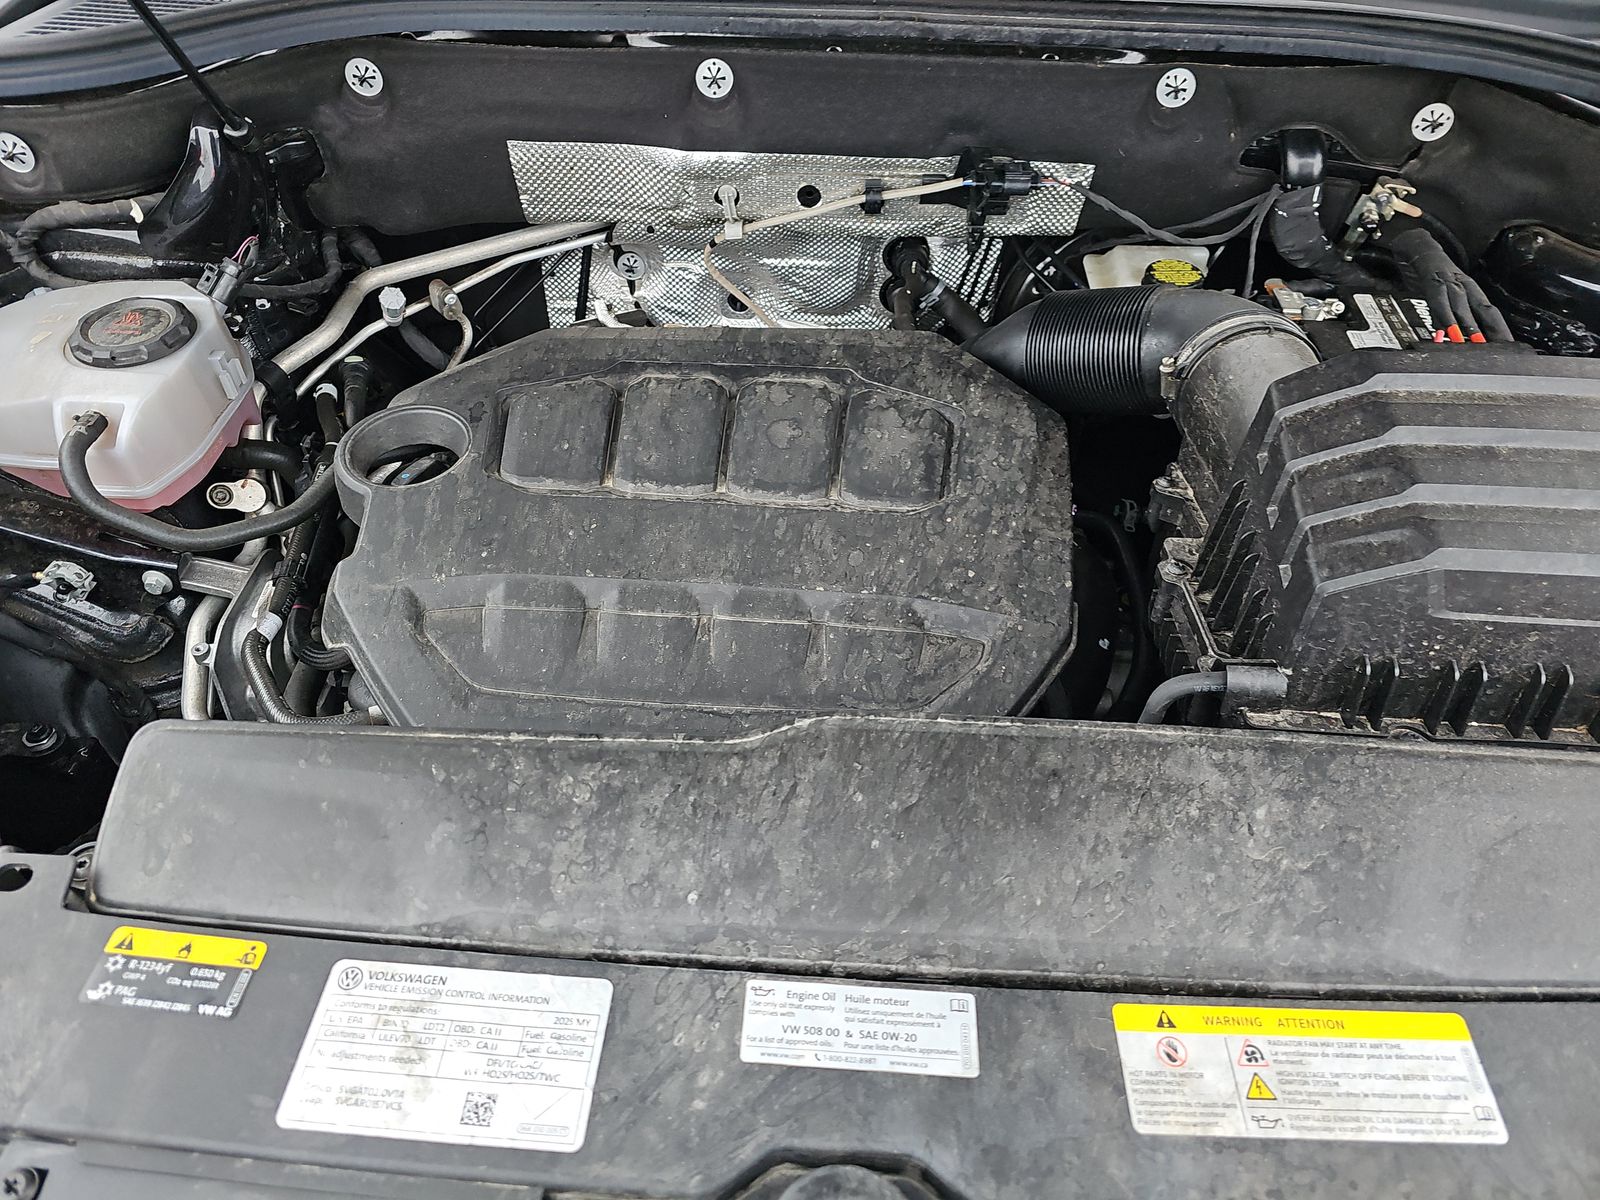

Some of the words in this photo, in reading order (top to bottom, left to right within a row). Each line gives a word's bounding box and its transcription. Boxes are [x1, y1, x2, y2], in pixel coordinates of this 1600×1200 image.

[128, 959, 174, 975] R-1234yf
[215, 970, 226, 981] kg
[368, 970, 448, 986] VOLKSWAGEN
[114, 985, 138, 997] PAG
[364, 982, 398, 993] VEHICLE
[401, 986, 443, 997] EMISSION
[445, 989, 485, 1000] CONTROL
[488, 992, 550, 1005] INFORMATION
[786, 990, 819, 1002] Engine
[822, 991, 836, 1001] Oil
[844, 994, 871, 1005] Huile
[873, 997, 910, 1007] moteur
[198, 1004, 216, 1016] VW
[216, 1006, 233, 1018] AG
[378, 1003, 387, 1011] to
[763, 1001, 777, 1009] only
[804, 1004, 835, 1013] expressly
[844, 1007, 870, 1015] Utilisez
[872, 1010, 914, 1018] uniquement
[553, 1016, 574, 1025] 2025
[857, 1017, 884, 1025] satisfait
[1202, 1015, 1263, 1027] WARNING
[1277, 1017, 1346, 1030] ATTENTION
[347, 1015, 363, 1024] EPA
[453, 1025, 475, 1034] OBD:
[525, 1030, 545, 1040] Fuel:
[550, 1032, 587, 1043] Gasoline
[782, 1025, 801, 1035] VW
[803, 1026, 823, 1036] 508
[825, 1028, 840, 1037] 00
[845, 1030, 853, 1038] &
[859, 1030, 878, 1040] SAE
[881, 1031, 917, 1042] 0W-20
[891, 1045, 917, 1053] d'huiles
[331, 1051, 386, 1063] adjustments
